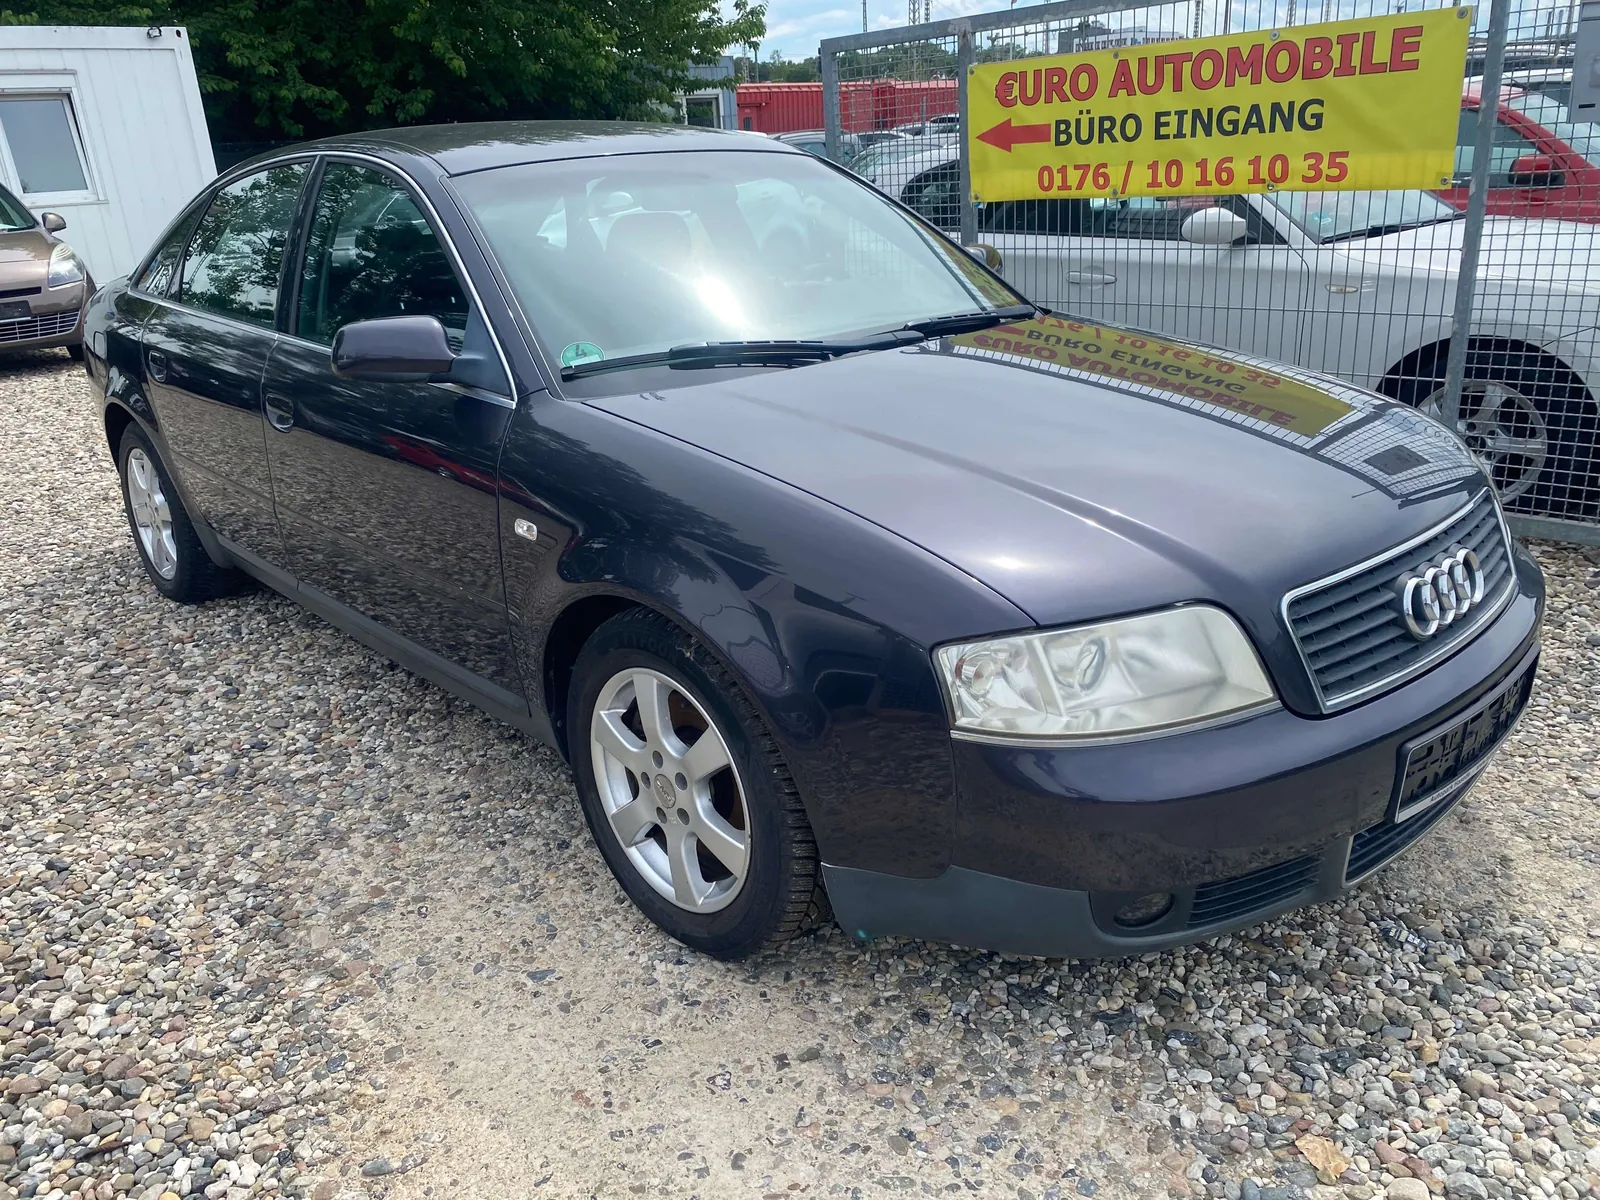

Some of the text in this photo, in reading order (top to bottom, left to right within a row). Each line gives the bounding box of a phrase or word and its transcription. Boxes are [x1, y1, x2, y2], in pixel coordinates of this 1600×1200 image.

[995, 25, 1424, 107] €URO AUTOMOBILE
[1054, 99, 1325, 146] BÜRO EINGANG
[1038, 151, 1349, 194] 0176 / 10 16 10 35
